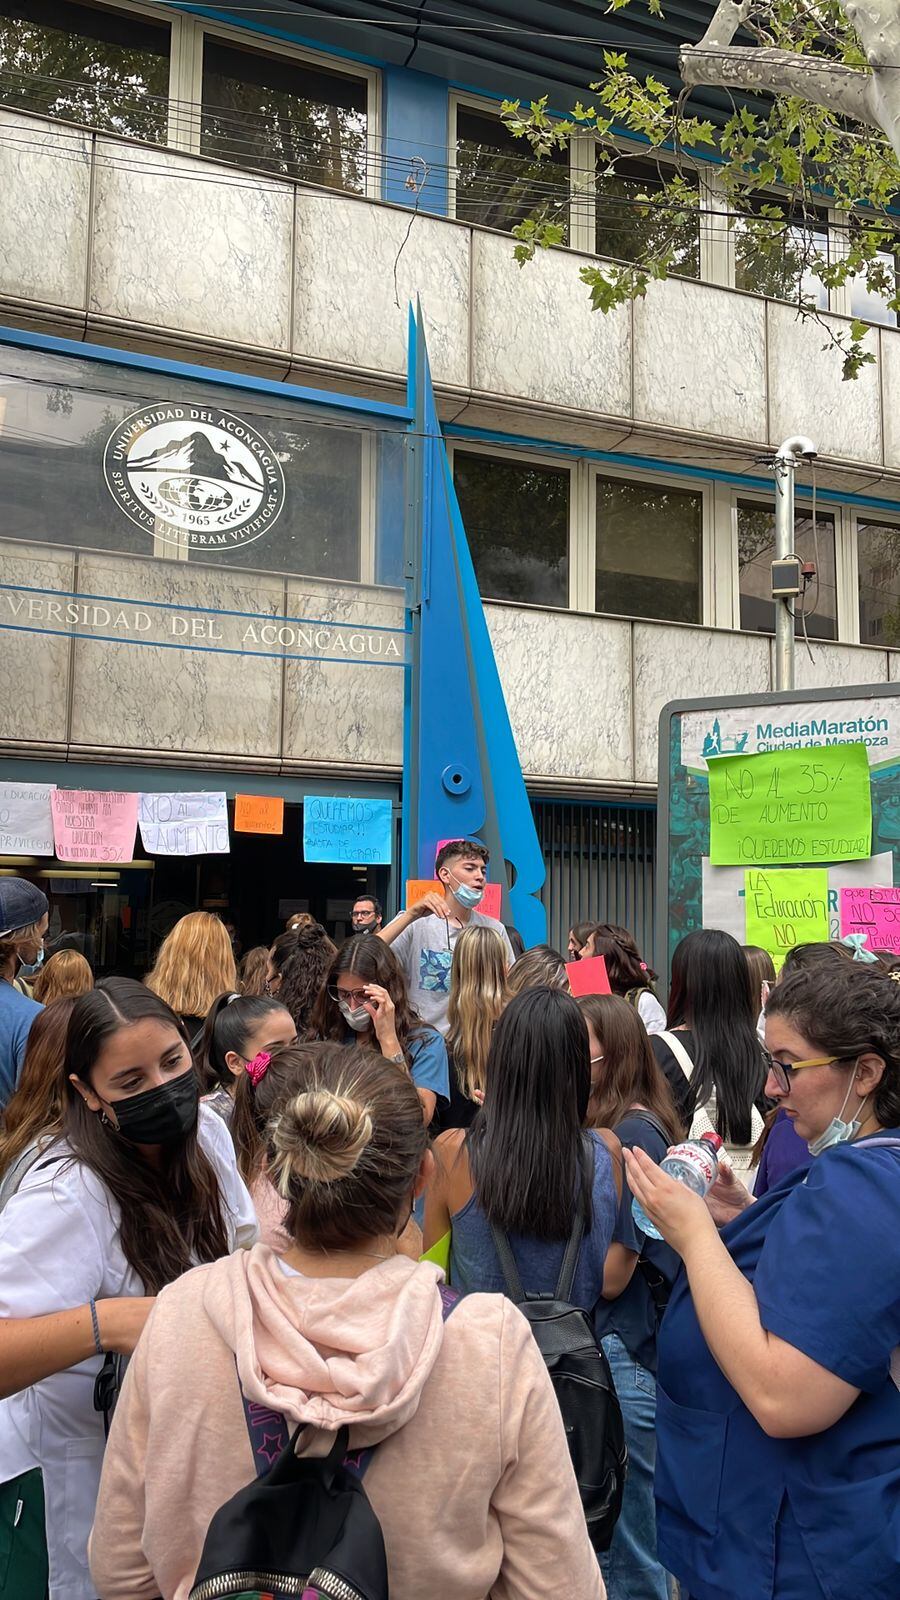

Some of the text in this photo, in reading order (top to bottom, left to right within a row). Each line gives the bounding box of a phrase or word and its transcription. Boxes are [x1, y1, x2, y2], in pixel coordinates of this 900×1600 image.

[113, 408, 278, 484] UNIVERSIDAD DEL ACONCAGUA
[112, 471, 278, 544] SPIRITUS LITTERAM VIVIFICAT
[182, 513, 210, 526] 1965
[1, 596, 401, 656] VERSIDAD DEL ACONCAGUA
[756, 716, 888, 739] MediaMaratón
[725, 763, 845, 800] NO AL 35%
[141, 794, 172, 823] NO
[178, 803, 191, 817] AL
[310, 799, 374, 821] QUEREMOS
[713, 802, 828, 824] DE AUMENTO
[156, 825, 228, 853] AUMENTO
[812, 835, 869, 856] ESTUDIAR!
[749, 872, 772, 892] LA
[754, 892, 827, 921] Educación
[851, 902, 875, 922] NO
[773, 923, 797, 946] NO
